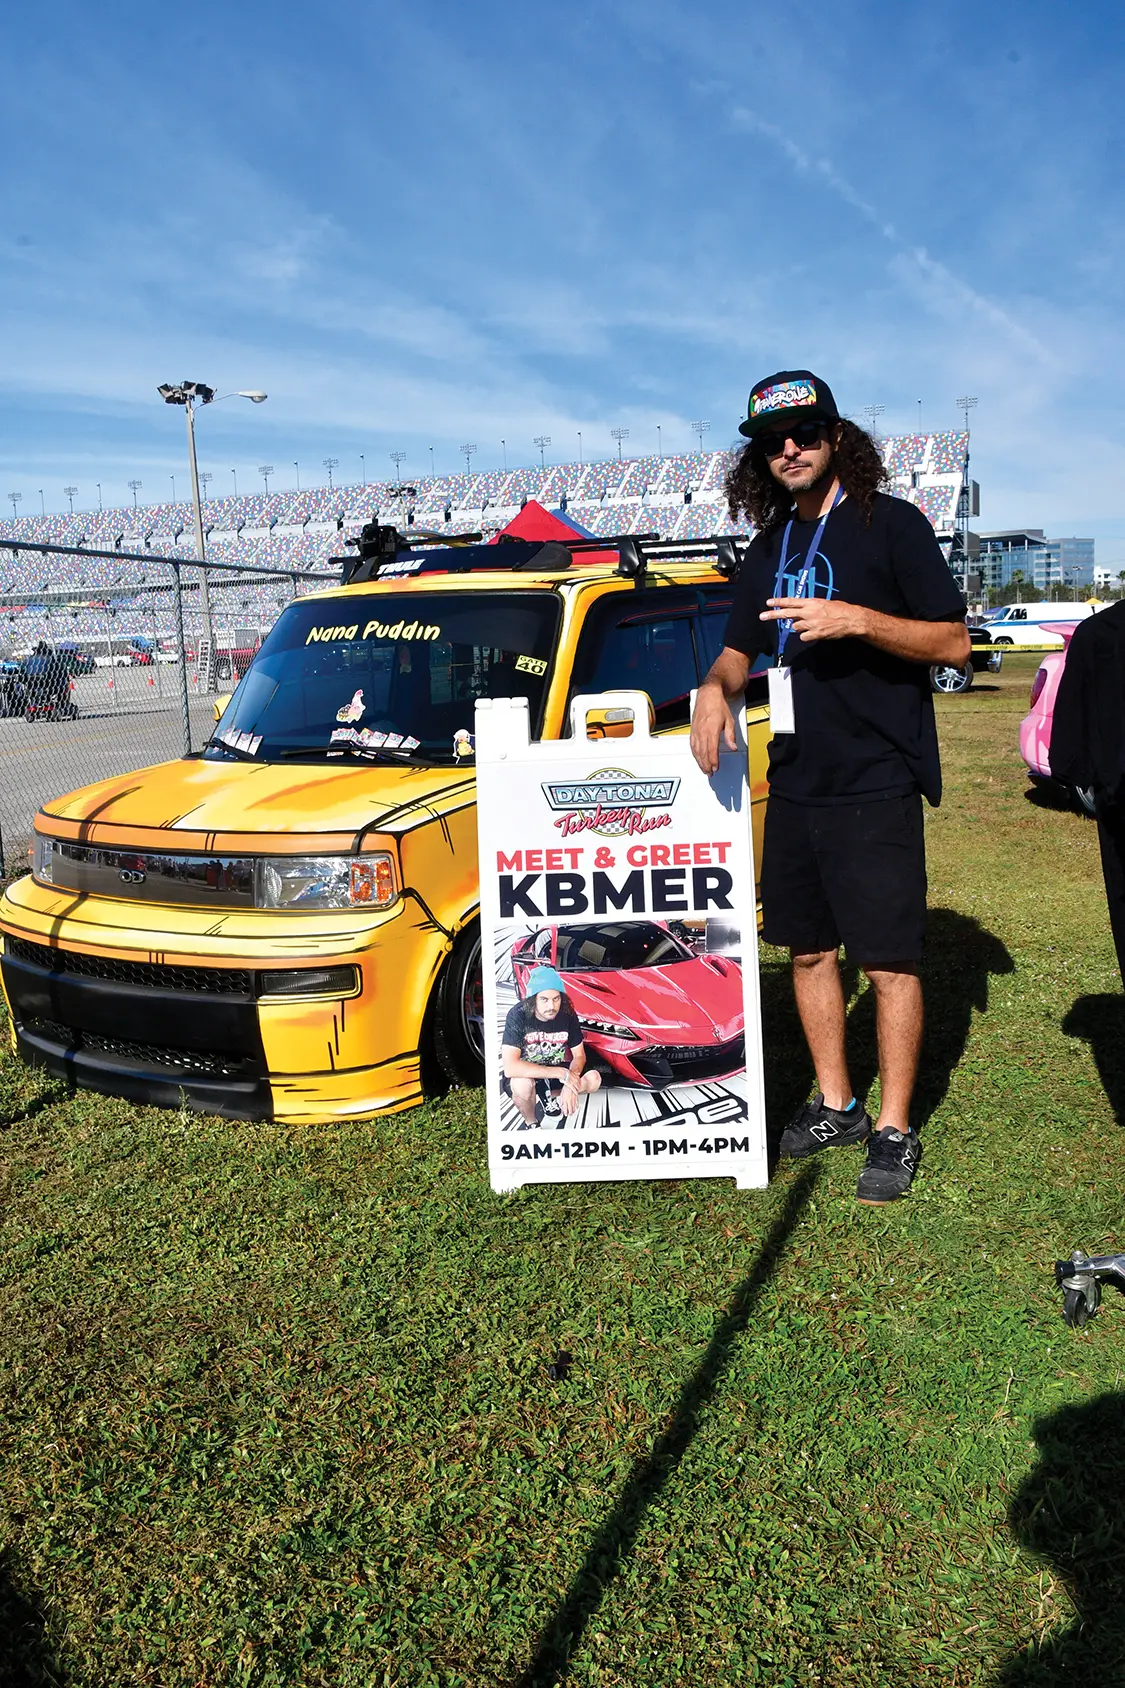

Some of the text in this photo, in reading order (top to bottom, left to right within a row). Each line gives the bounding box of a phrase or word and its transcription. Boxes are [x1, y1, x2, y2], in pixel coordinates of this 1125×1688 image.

[376, 558, 426, 575] THULE
[306, 619, 441, 645] Nana Puddin
[517, 662, 544, 674] 40
[520, 656, 546, 666] GATE
[556, 783, 669, 803] DAYTONA
[553, 804, 672, 838] Turkey Run
[496, 842, 732, 872] MEET & GREET
[498, 867, 735, 918] KBMER
[501, 1141, 620, 1160] 9AM-12PM
[642, 1136, 749, 1156] 1PM-4PM
